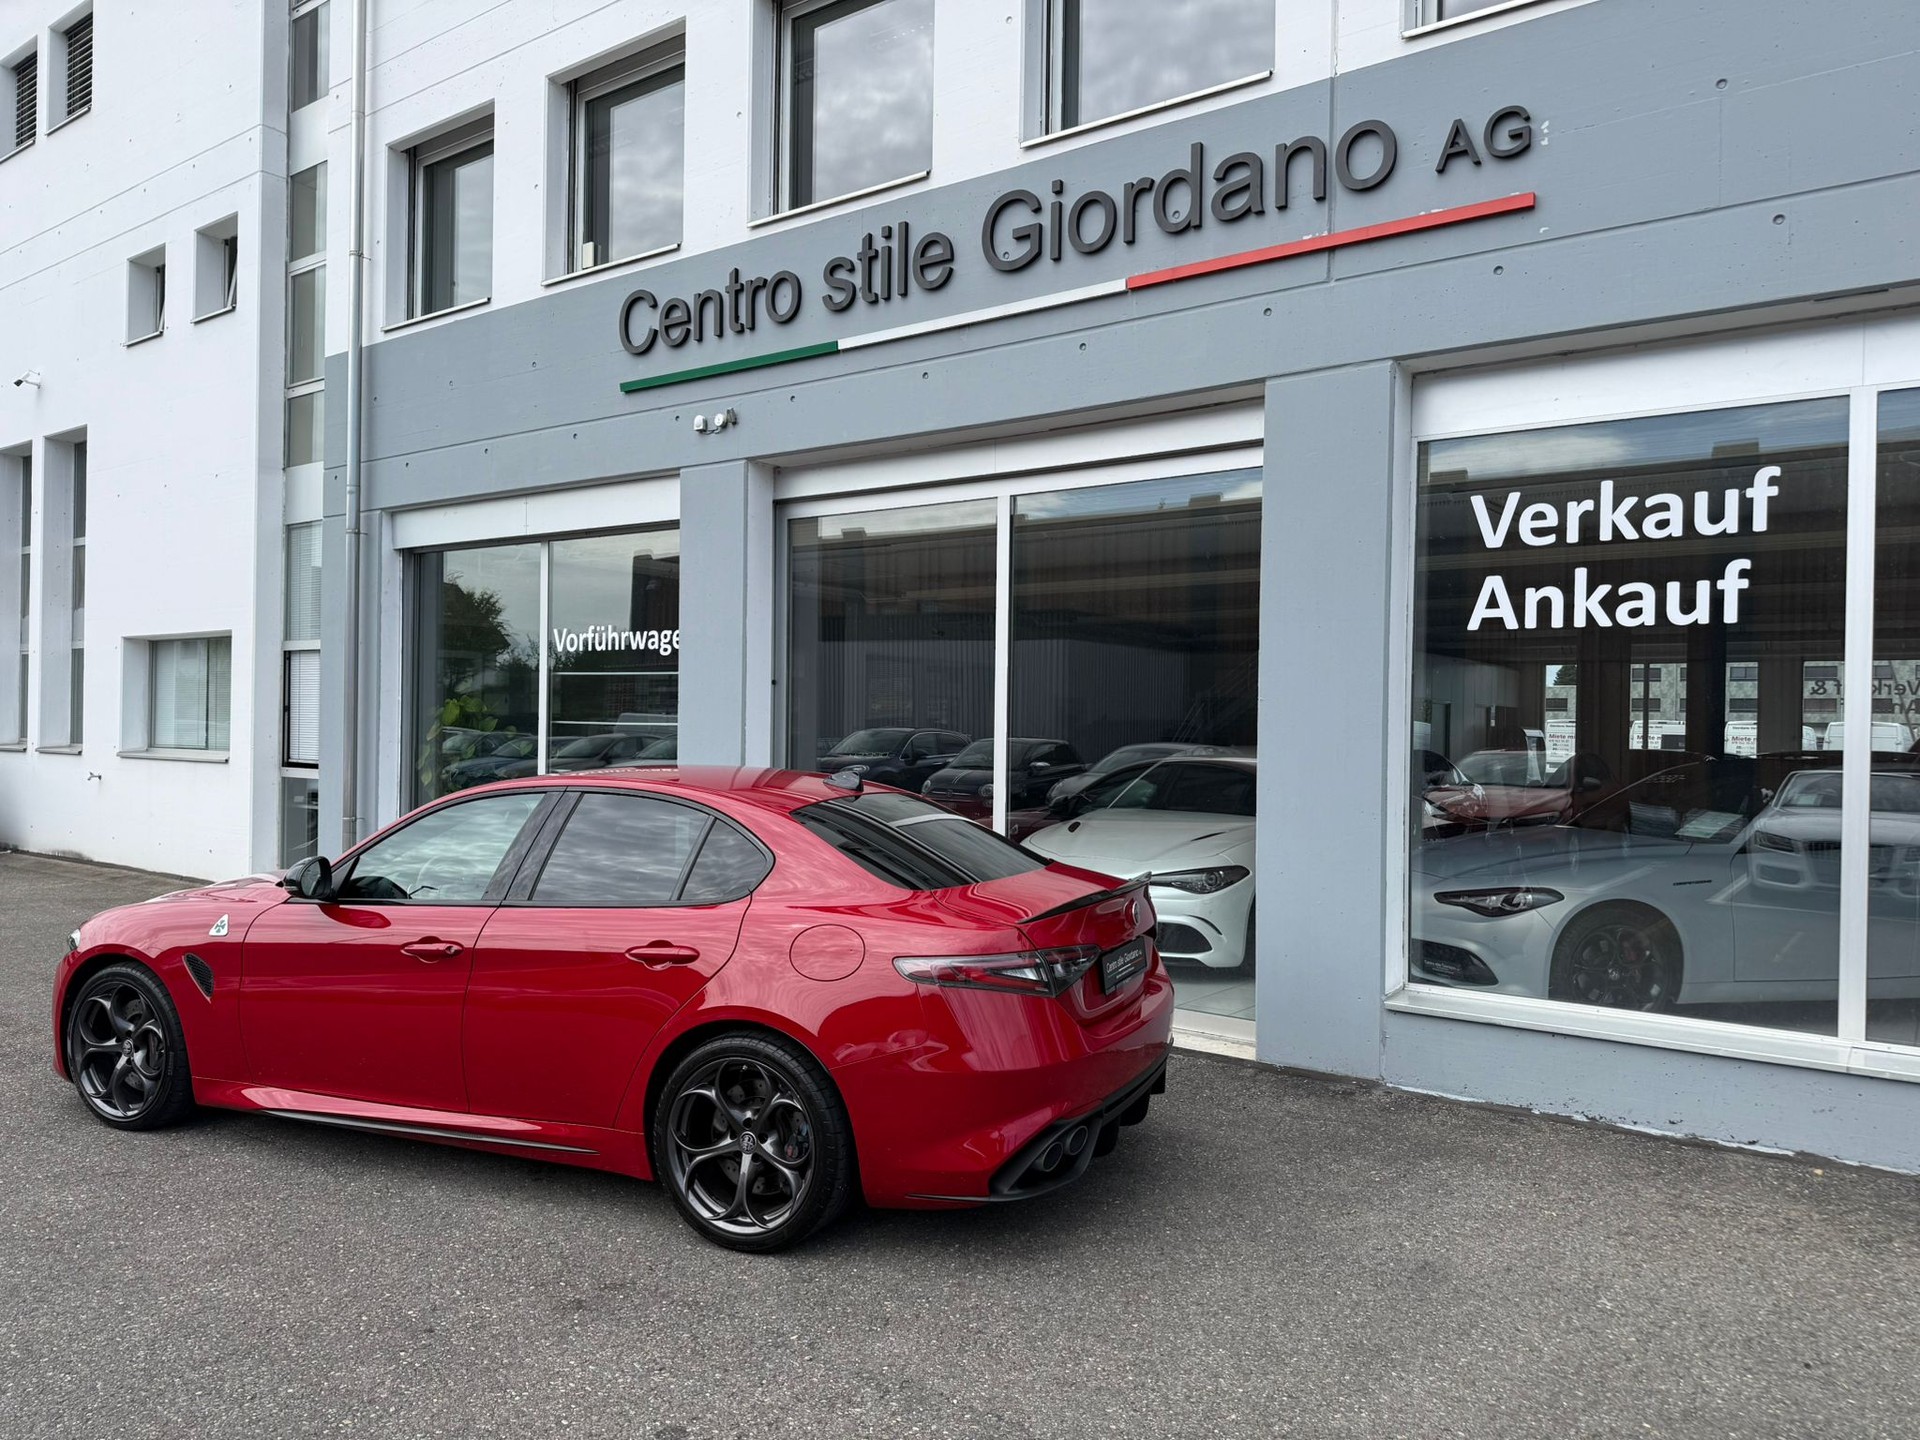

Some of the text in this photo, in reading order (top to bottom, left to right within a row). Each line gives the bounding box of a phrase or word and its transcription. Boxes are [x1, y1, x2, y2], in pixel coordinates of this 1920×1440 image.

[619, 105, 1533, 355] Centro stile Giordano AG
[1470, 465, 1782, 549] Verkauf
[1466, 558, 1752, 631] Ankauf
